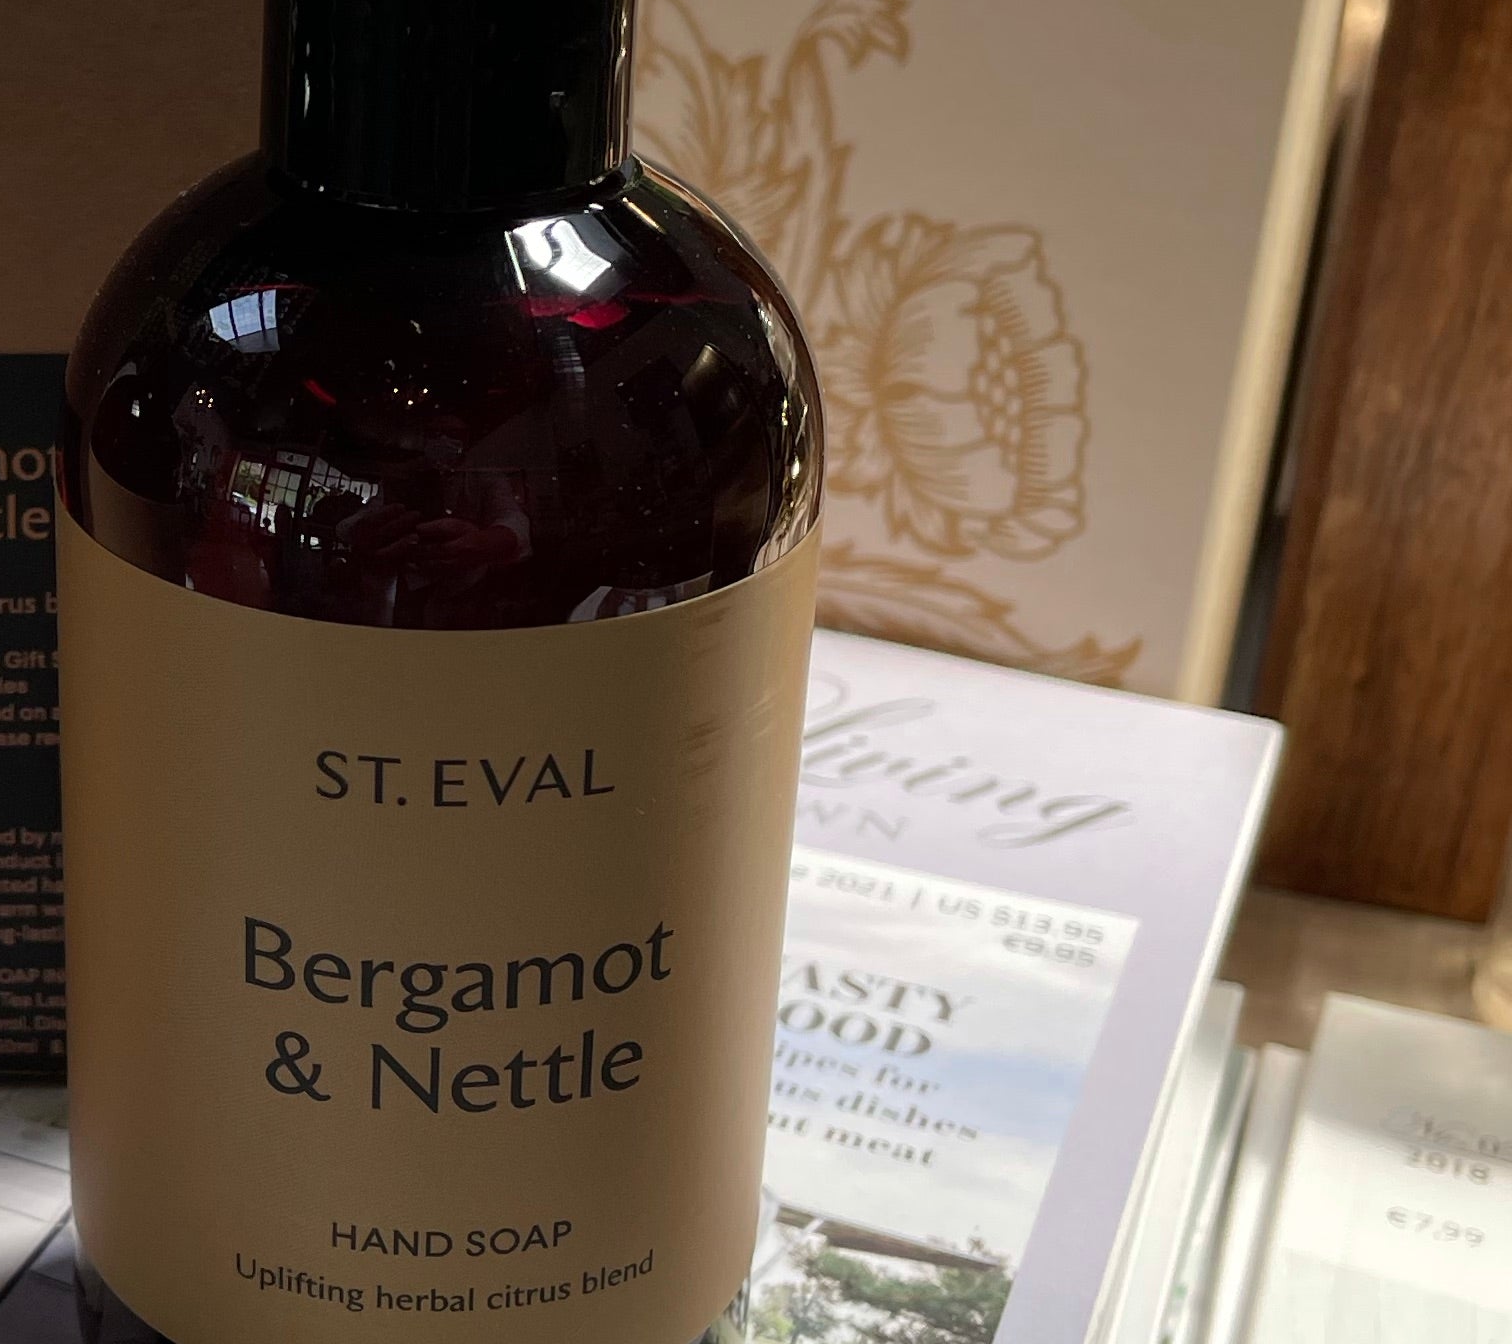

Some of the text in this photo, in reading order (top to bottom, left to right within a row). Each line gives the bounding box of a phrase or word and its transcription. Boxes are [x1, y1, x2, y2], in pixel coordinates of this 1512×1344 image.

[3, 650, 47, 670] Gift
[19, 706, 47, 721] on
[315, 748, 615, 808] ST. EVAL
[244, 915, 675, 1034] Bergamot
[264, 1028, 644, 1114] & Nettle
[874, 1063, 940, 1094] for
[836, 1090, 979, 1141] dishes
[823, 1125, 936, 1168] meat
[331, 1219, 572, 1258] HAND SOAP
[235, 1248, 654, 1312] Uplifting herbal citrus blend
